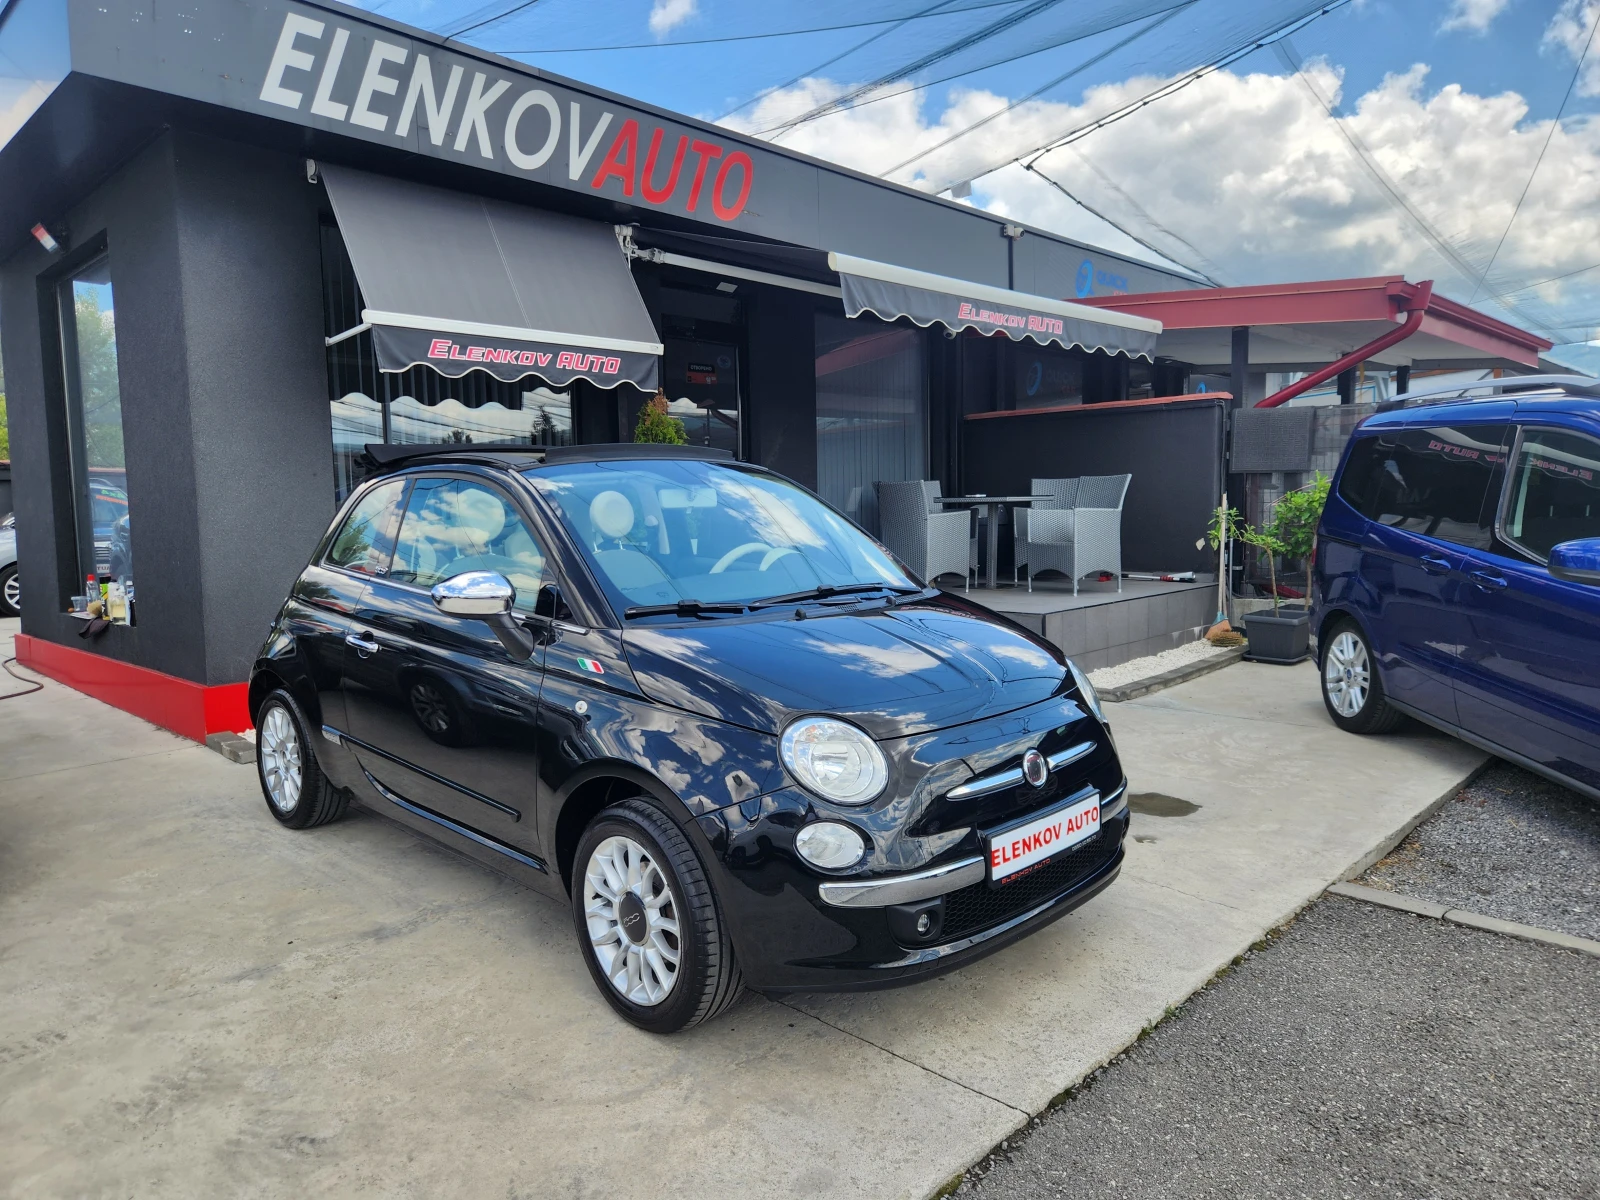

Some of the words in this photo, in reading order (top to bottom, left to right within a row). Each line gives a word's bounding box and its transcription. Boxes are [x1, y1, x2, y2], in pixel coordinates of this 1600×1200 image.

[958, 302, 1026, 328] ELENKOV
[1027, 315, 1063, 335] AUTO
[427, 338, 552, 367] ELENKOV
[556, 351, 621, 374] AUTO
[991, 822, 1062, 868] ELENKOV
[1066, 806, 1099, 835] AUTO
